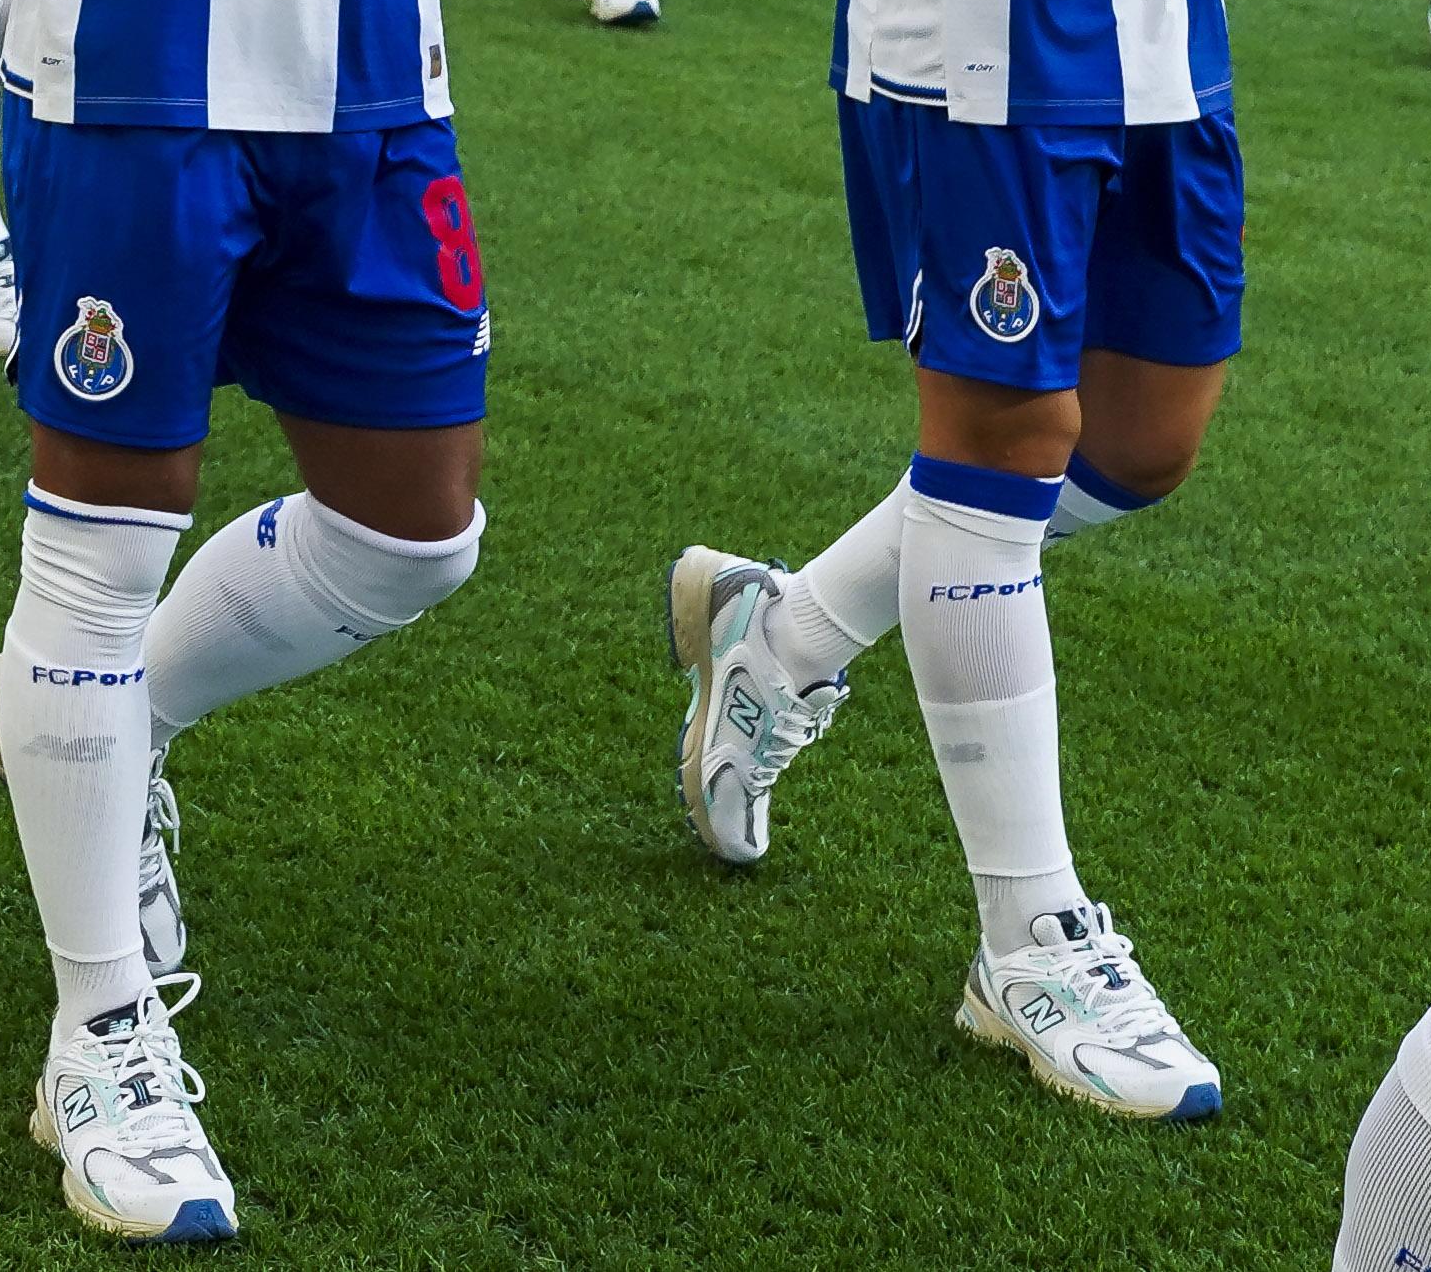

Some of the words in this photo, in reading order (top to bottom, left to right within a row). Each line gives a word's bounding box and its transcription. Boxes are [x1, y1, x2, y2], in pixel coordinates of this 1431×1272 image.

[421, 188, 482, 311] 8
[1021, 992, 1067, 1034] N
[62, 1083, 97, 1133] N
